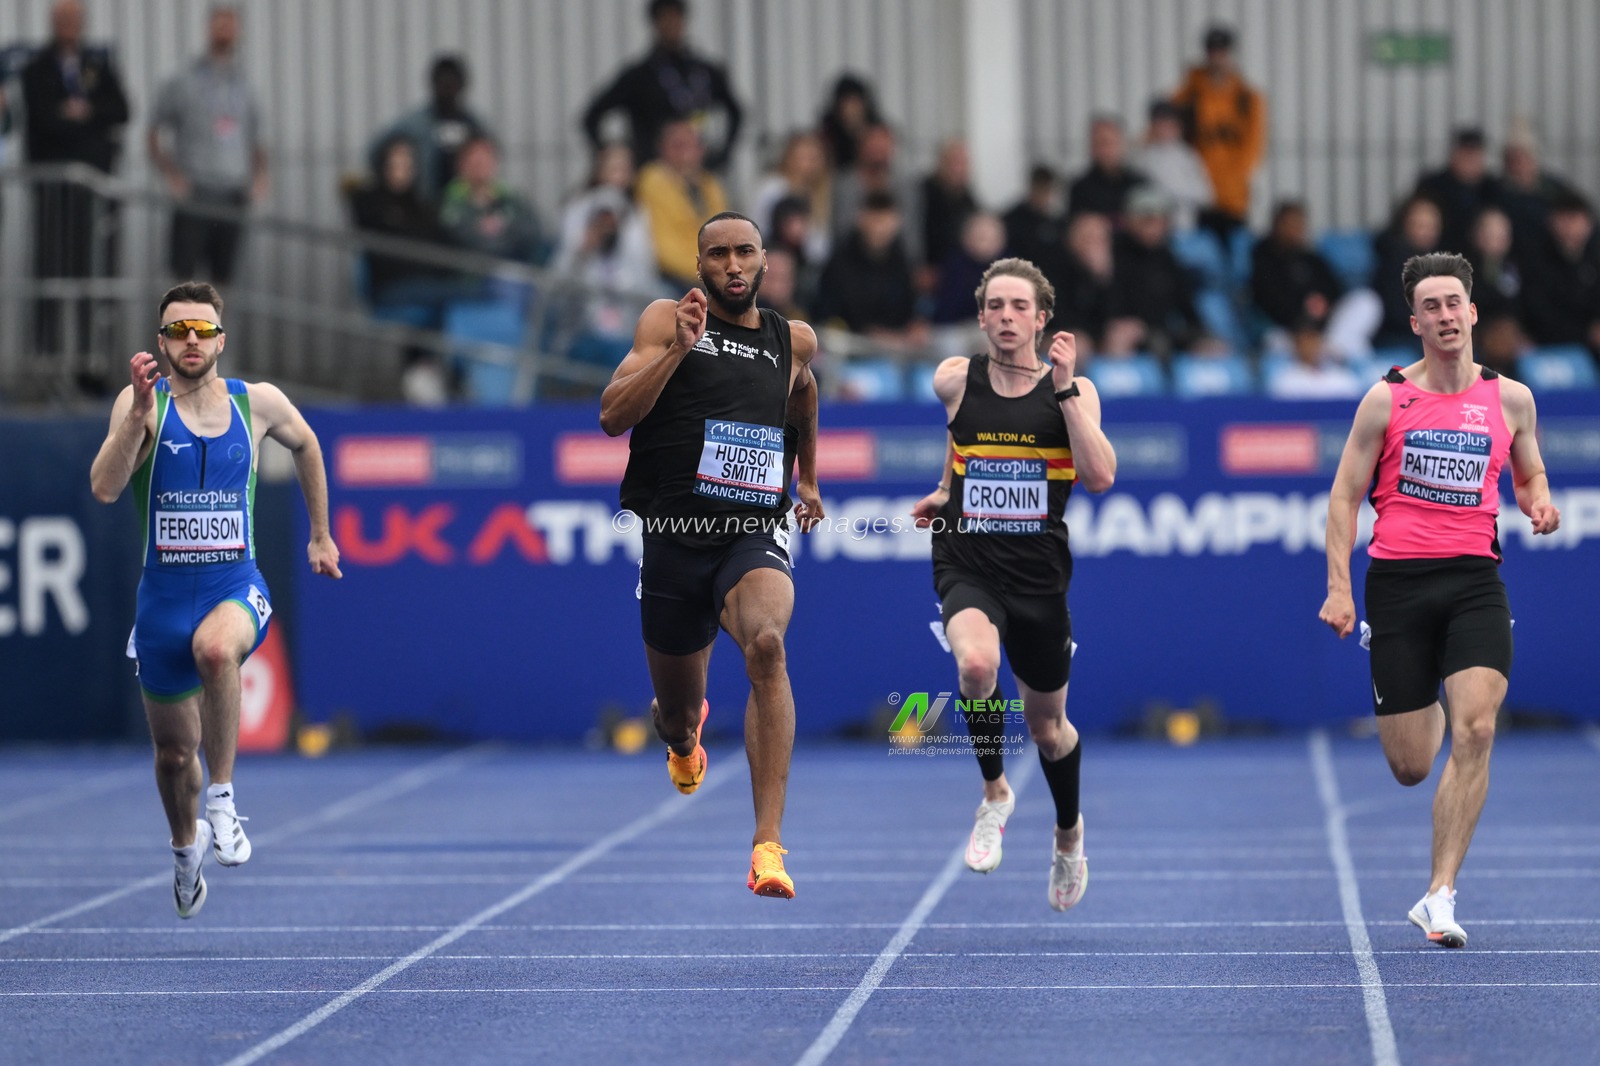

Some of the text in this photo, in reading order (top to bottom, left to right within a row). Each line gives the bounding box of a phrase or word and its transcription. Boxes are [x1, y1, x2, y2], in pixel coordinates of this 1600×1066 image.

[737, 350, 755, 360] Frank
[738, 343, 759, 354] Knight
[728, 436, 760, 446] PROCESSING
[977, 432, 1035, 443] WALTON AC
[1426, 442, 1459, 450] PROCESSING
[715, 445, 775, 468] HUDSON
[1405, 452, 1485, 482] PATTERSON
[721, 463, 767, 484] SMITH
[699, 482, 777, 505] MANCHESTER
[969, 485, 1039, 509] CRONIN
[1402, 482, 1477, 505] MANCHESTER
[160, 517, 239, 541] FERGUSON
[334, 502, 456, 567] UK
[967, 519, 1041, 532] MANCHESTER
[162, 550, 239, 563] MANCHESTER
